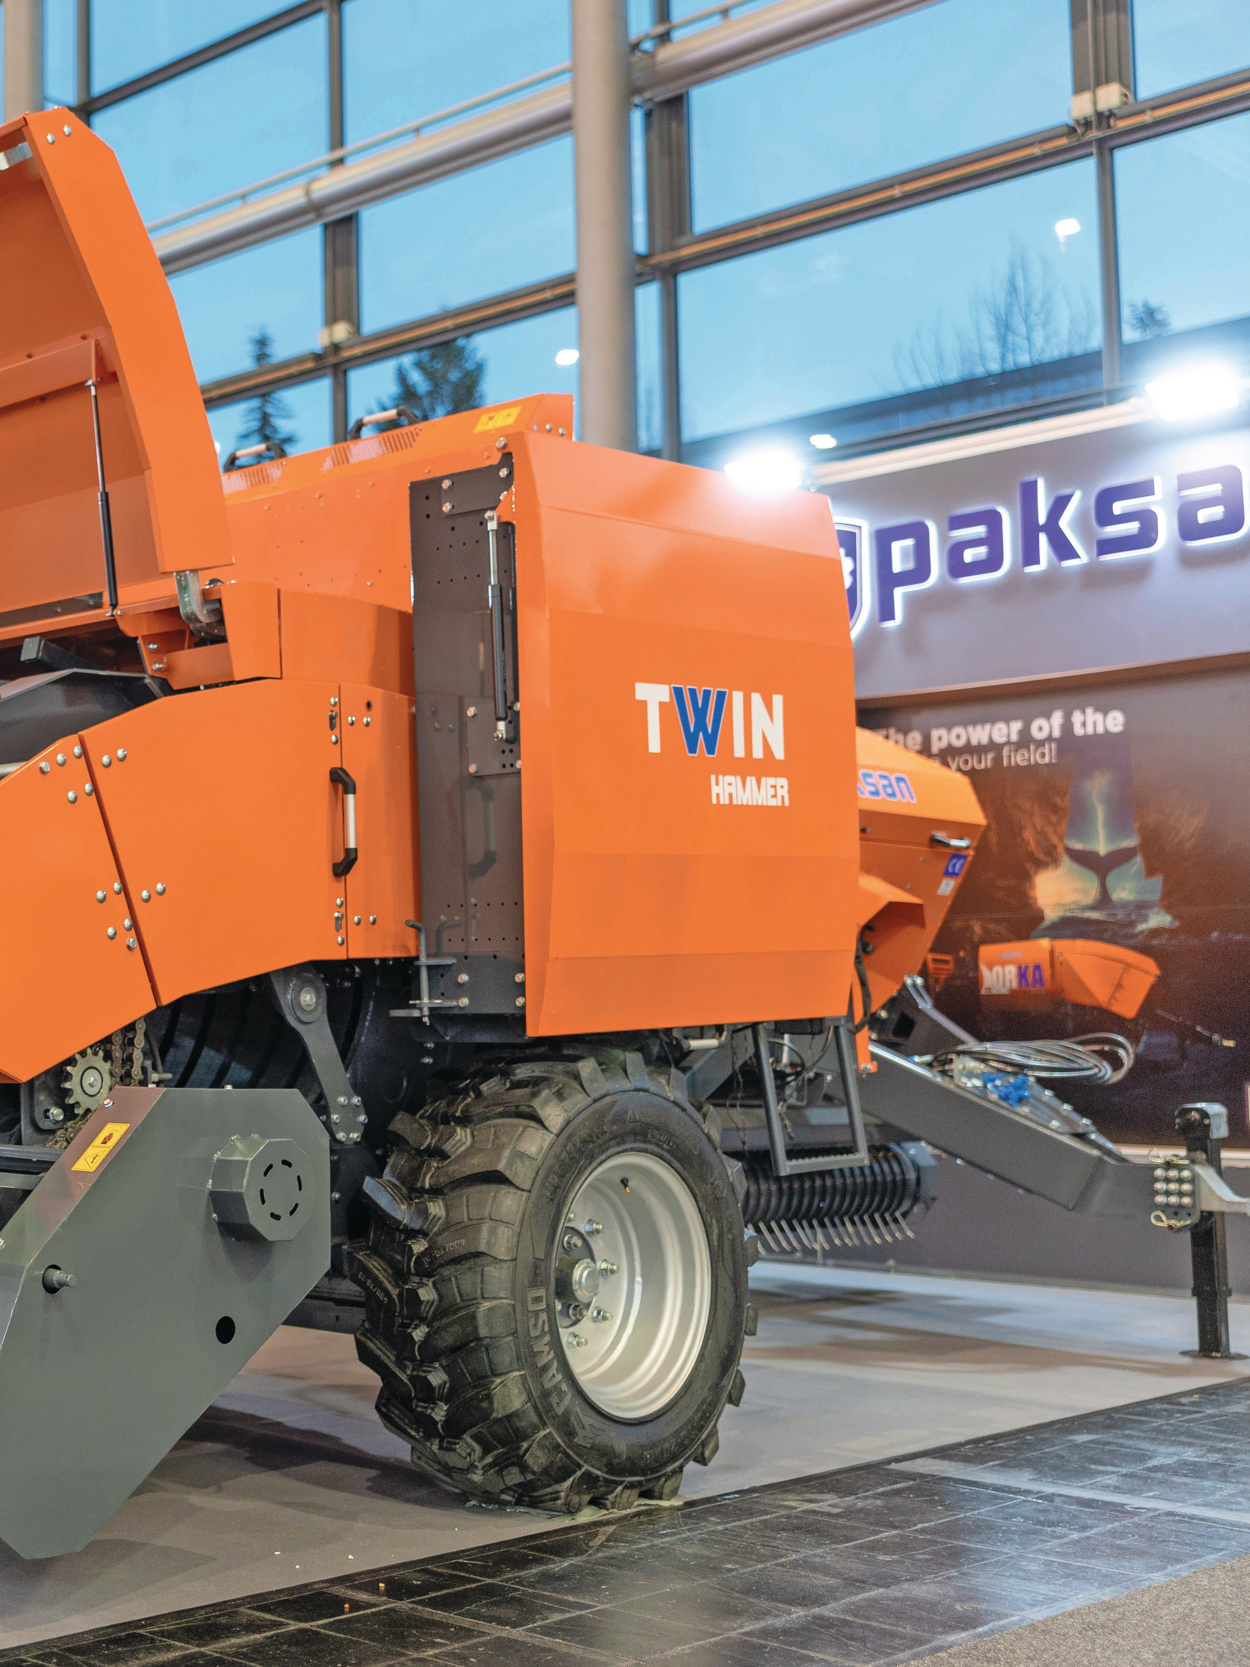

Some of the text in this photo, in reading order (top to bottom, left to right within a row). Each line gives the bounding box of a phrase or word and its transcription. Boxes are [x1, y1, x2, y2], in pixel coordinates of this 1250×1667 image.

[873, 463, 1248, 628] paksa
[635, 682, 785, 760] TWIN
[874, 706, 1125, 754] he power of the
[947, 751, 995, 772] your
[1003, 741, 1058, 768] field!
[710, 775, 789, 806] HAMMER
[857, 769, 917, 803] san
[526, 1286, 573, 1416] CAMSO
